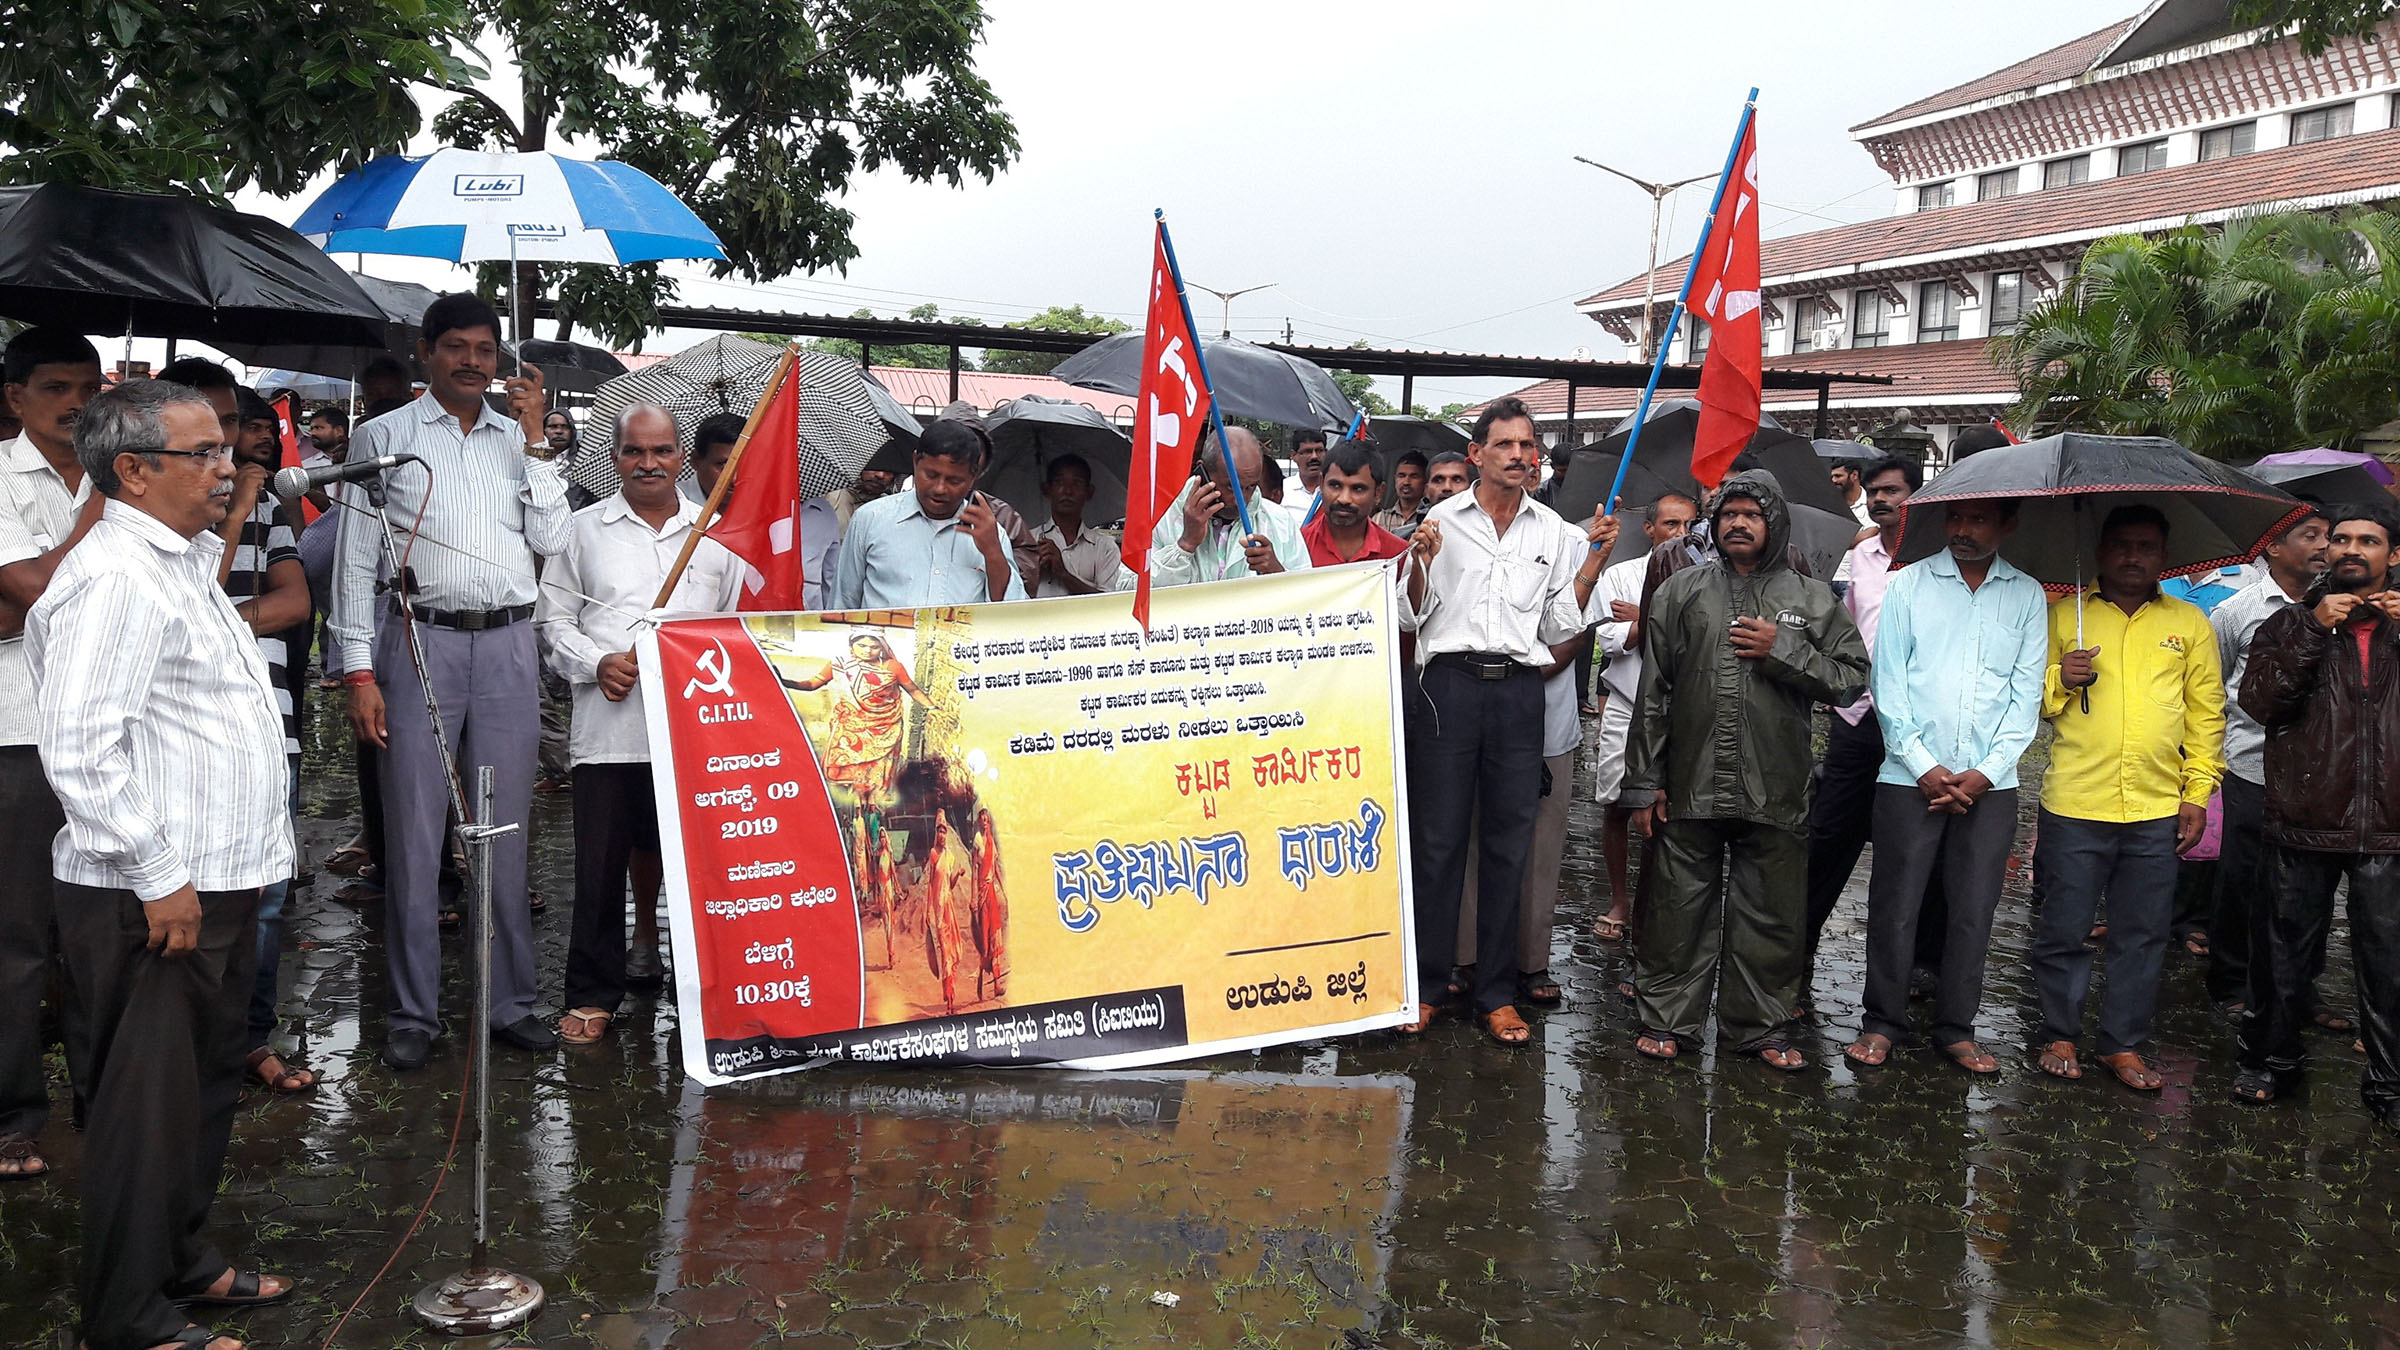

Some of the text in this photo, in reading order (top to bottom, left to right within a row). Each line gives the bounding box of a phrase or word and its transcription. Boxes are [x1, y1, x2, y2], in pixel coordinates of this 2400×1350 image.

[465, 179, 516, 191] Lubi
[954, 643, 980, 663] ಕೇಂದ್ರ
[984, 639, 1025, 658] ಸರಕಾರದ
[1028, 636, 1065, 660] ಉದ್ದೇಶಿತ
[1110, 630, 1140, 652] ಸುರಕ್ಷಾ
[1183, 625, 1210, 647] ಕಲ್ಯಾಣ
[1214, 617, 1275, 638] ಮಸೂದೆ-2018
[1278, 613, 1303, 636] ಯನ್ನು
[1305, 612, 1316, 637] ಕೈ
[1318, 612, 1343, 628] ಬಿಡಲು
[958, 675, 981, 699] ಕಟ್ಟಡ
[985, 670, 1021, 689] ಕಾರ್ಮಿಕ
[1025, 664, 1093, 687] ಕಾನೂನು-1996
[1097, 661, 1124, 679] ಹಾಗೂ
[1127, 659, 1146, 675] ಸೆಸ್
[1150, 656, 1186, 674] ಕಾನೂನು
[1189, 653, 1211, 675] ಮತ್ತು
[1214, 651, 1235, 675] ಕಟ್ಟಡ
[1239, 648, 1273, 666] ಕಾರ್ಮಿಕ
[1276, 646, 1304, 669] ಕಲ್ಯಾಣ
[1307, 642, 1336, 660] ಮಂಡಳಿ
[698, 701, 753, 725] C.I.T.U.
[1080, 695, 1102, 719] ಕಟ್ಟಡ
[1106, 690, 1147, 709] ಕಾರ್ಮಿಕರ
[1150, 686, 1188, 709] ಬದುಕನ್ನು
[1191, 683, 1222, 707] ರಕ್ಷಿಸಲು
[1010, 711, 1305, 755] ಕಡಿಮೆ ದರದಲ್ಲಿ ಮರಳು ನೀಡಲು ಒತ್ತಾಯಿಸಿ
[706, 747, 781, 773] ದಿನಾಂಕ
[767, 781, 799, 800] 09
[1175, 746, 1362, 820] ಕಟ್ಟಡ ಕಾರ್ಮಿಕರ
[721, 816, 778, 840] 2019
[727, 859, 796, 882] ಮಣಿಪಾಲ
[1053, 798, 1386, 932] ಪ್ರತಿಭಟನಾ ಧರಣಿ
[705, 886, 837, 920] ಜಿಲ್ಲಾಧಿಕಾರಿ ಕಛೇರಿ
[744, 937, 795, 970] ಬೆಳಿಗ್ಗೆ
[734, 975, 812, 1007] 10.30ಕ್ಕೆ
[1226, 961, 1368, 1011] ಉಡುಪಿ ಜಿಲ್ಲೆ
[714, 1046, 764, 1073] ಉಡುಪಿ
[975, 1012, 1038, 1058] ಸಮನ್ವಯ
[1043, 1009, 1086, 1040] ಸಮಿತಿ
[1091, 993, 1166, 1038] (ಸಿಐಟಿಯು)
